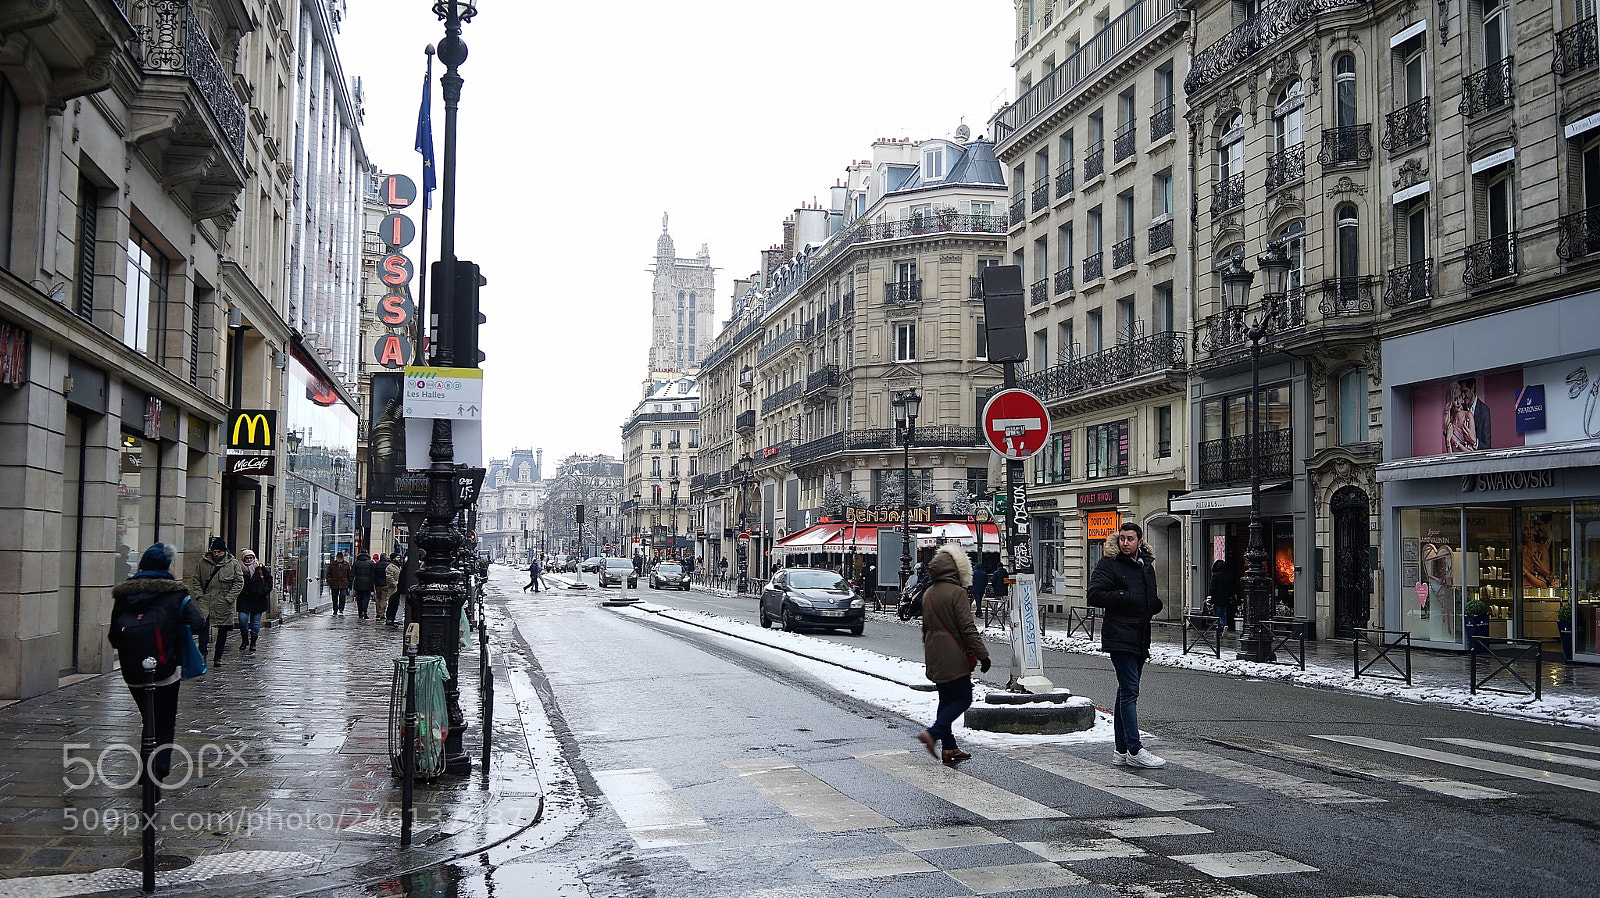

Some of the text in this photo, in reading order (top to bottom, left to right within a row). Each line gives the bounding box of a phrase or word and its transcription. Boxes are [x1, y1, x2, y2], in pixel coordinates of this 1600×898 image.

[380, 177, 409, 365] LISSA
[406, 390, 446, 399] Les Halles
[1517, 404, 1543, 415] SWAROVSKI
[1478, 469, 1554, 492] SWAROVSKI
[1079, 491, 1113, 504] OUTLET RIVOLI
[846, 506, 931, 523] BENJAMIN
